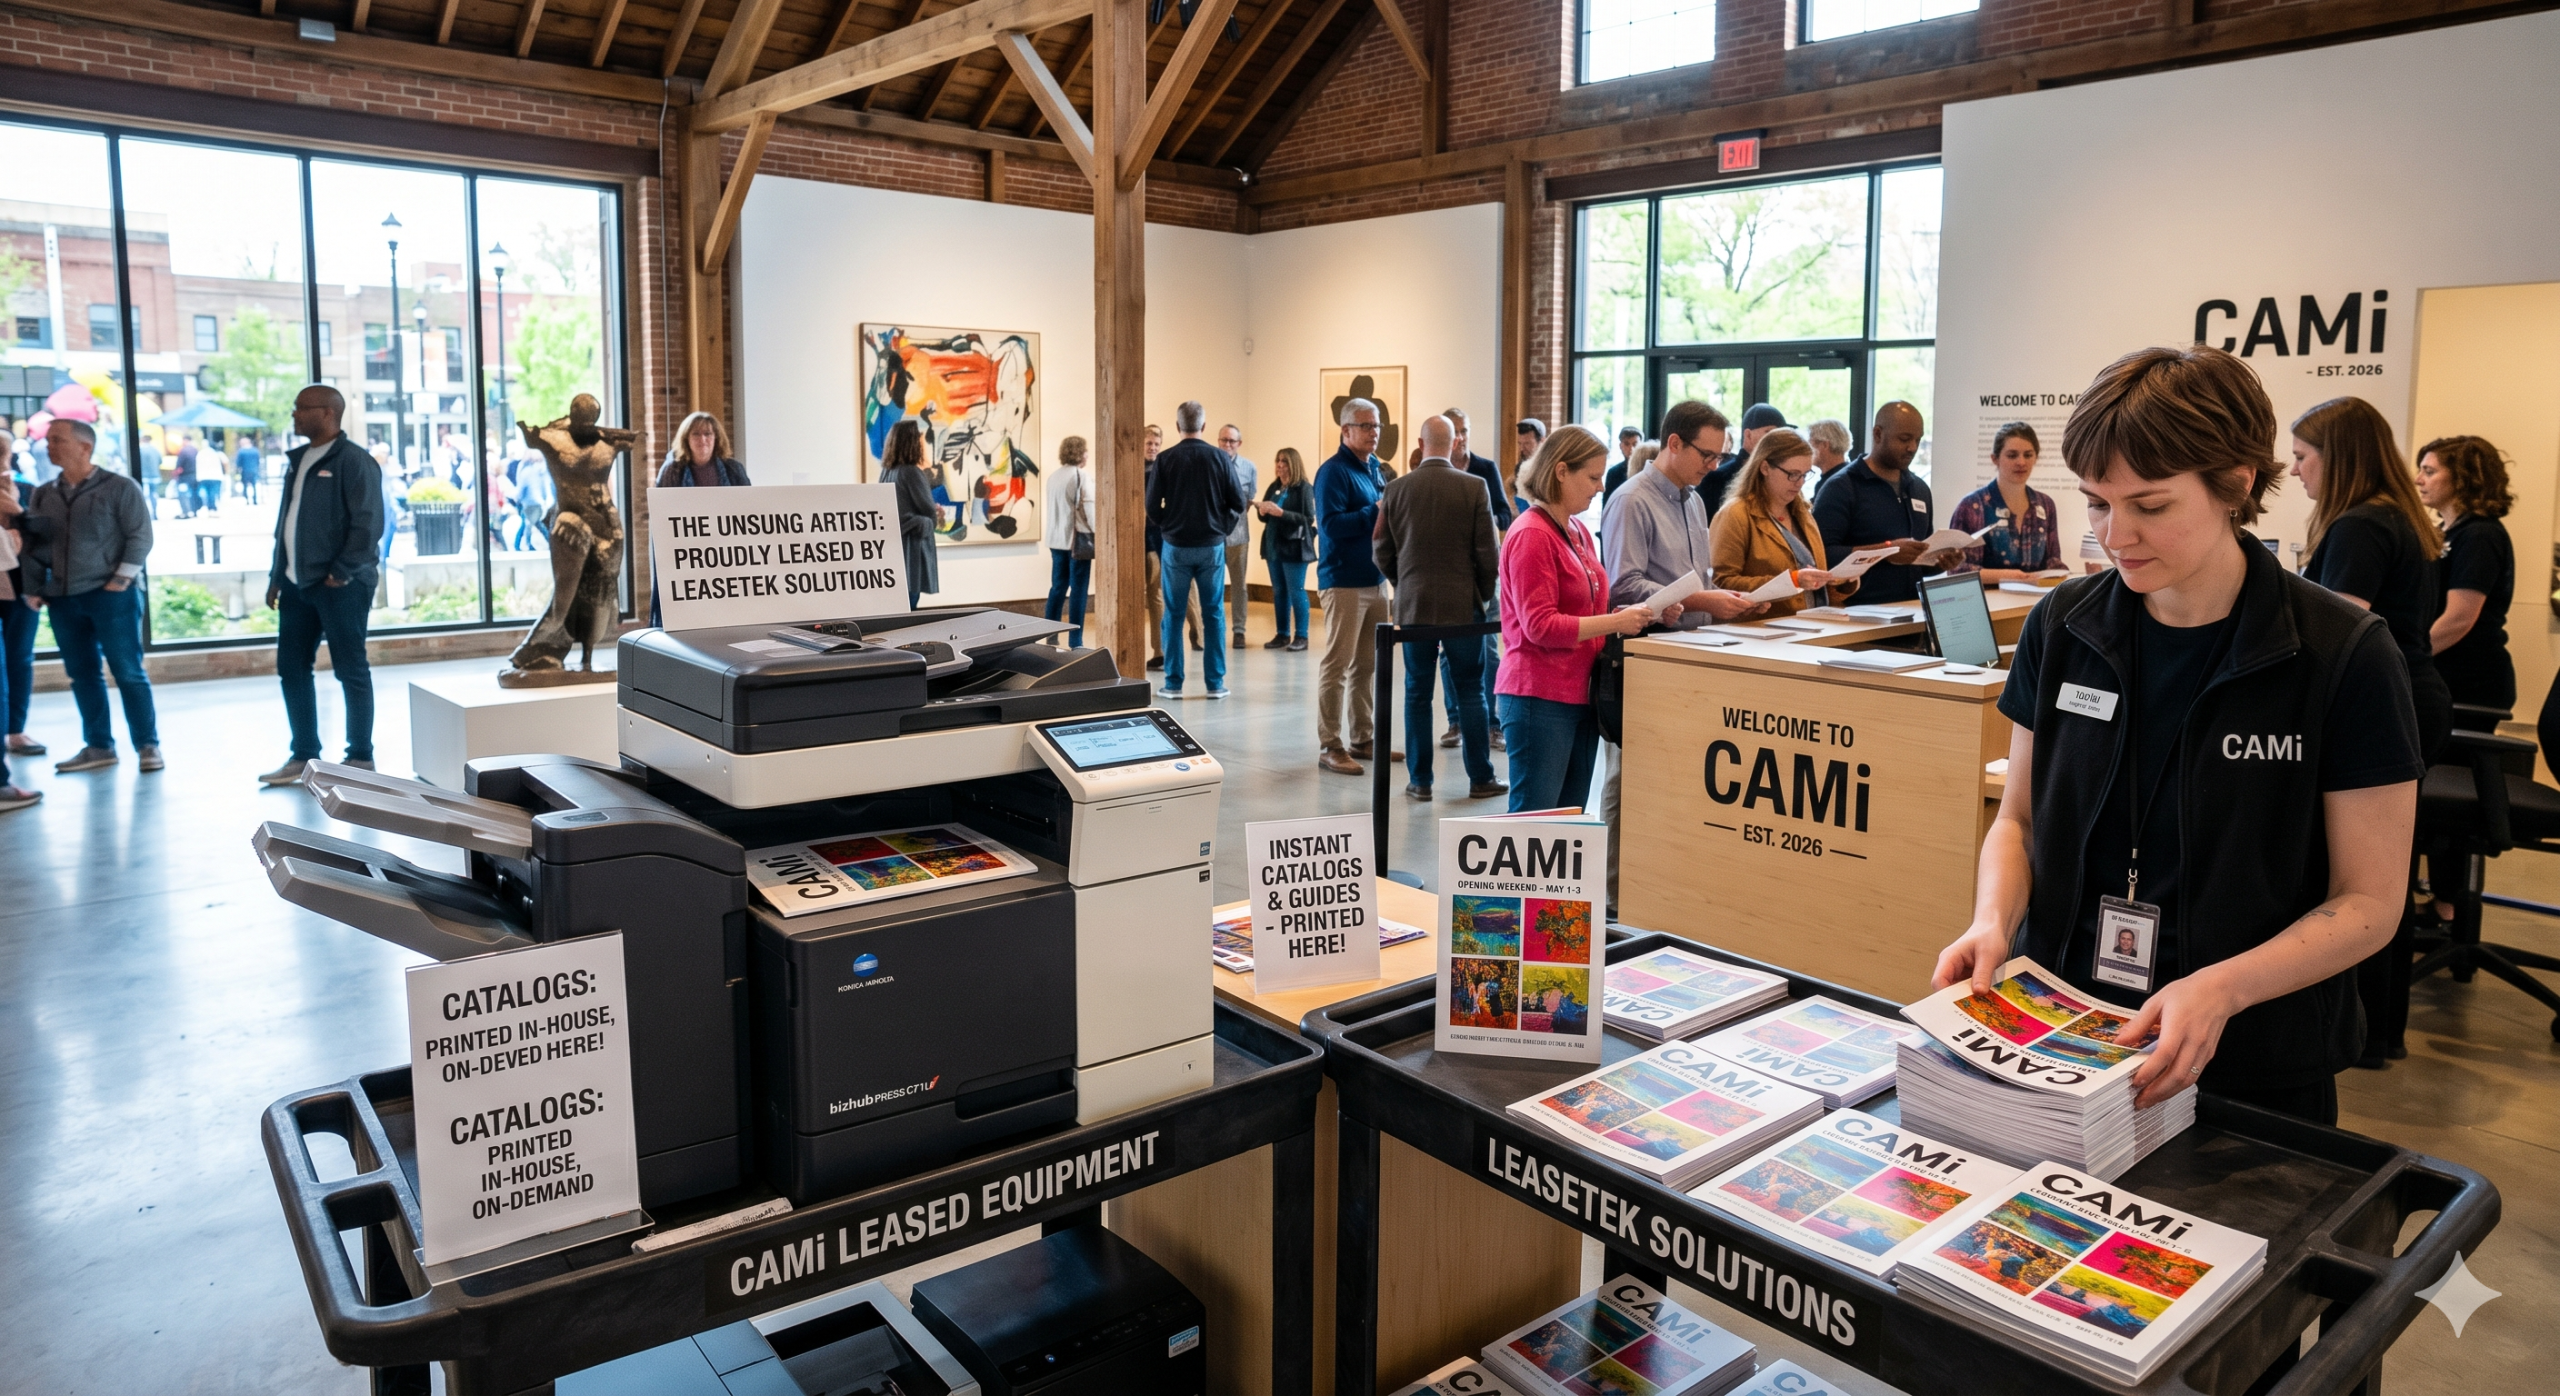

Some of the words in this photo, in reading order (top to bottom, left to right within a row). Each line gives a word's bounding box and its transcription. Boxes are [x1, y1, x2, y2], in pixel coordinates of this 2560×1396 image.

[1723, 139, 1755, 169] EXIT
[2194, 289, 2388, 358] CAMi
[2317, 365, 2344, 377] EST.
[2348, 364, 2384, 376] 2026
[1980, 394, 2037, 407] WELCOME
[2040, 394, 2055, 406] TO
[668, 516, 710, 538] THE
[717, 513, 803, 536] UNSUNG
[810, 511, 885, 533] ARTIST:
[674, 544, 771, 569] PROUDLY
[778, 541, 854, 564] LEASED
[860, 539, 885, 560] BY
[671, 574, 779, 601] LEASETEK
[785, 568, 896, 594] SOLUTIONS
[1723, 706, 1821, 743] WELCOME
[1827, 722, 1854, 748] TO
[2222, 733, 2302, 762] CAMi
[1704, 739, 1871, 833] CAMi
[1269, 834, 1352, 860] INSTANT
[1458, 834, 1583, 880] CAMi
[1743, 823, 1776, 847] EST.
[1781, 832, 1823, 857] 2026
[1261, 858, 1362, 885] CATALOGS
[1458, 880, 1494, 890] OPENING
[1497, 882, 1537, 892] WEEKEND
[1546, 884, 1564, 893] MAY
[1567, 886, 1581, 895] 1-3
[1268, 891, 1283, 911] &
[1289, 883, 1360, 909] GUIDES
[1281, 907, 1365, 934] PRINTED
[1288, 933, 1345, 958] HERE!
[442, 969, 597, 1021] CATALOGS:
[838, 982, 864, 993] KONICA
[865, 975, 894, 987] MINOLTA
[1603, 993, 1674, 1020] CAM
[425, 1025, 512, 1060] PRINTED
[519, 1005, 615, 1041] IN-HOUSE,
[442, 1045, 542, 1083] ON-DEVED
[547, 1032, 605, 1061] HERE!
[1660, 1048, 1773, 1098] CAMi
[1735, 1047, 1849, 1086] CAMi
[1952, 1028, 2087, 1085] CAMi
[450, 1088, 604, 1145] CATALOGS:
[830, 1094, 874, 1114] bizhub
[874, 1088, 905, 1103] PRESS
[488, 1128, 573, 1166] PRINTED
[1835, 1118, 1967, 1174] CAMi
[481, 1152, 582, 1192] IN-HOUSE,
[472, 1173, 594, 1220] ON-DEMAND
[730, 1233, 825, 1297] CAMi
[839, 1191, 970, 1266] LEASED
[982, 1130, 1160, 1220] EQUIPMENT
[2042, 1174, 2194, 1241] CAMi
[1487, 1137, 1641, 1246] LEASETEK
[1649, 1215, 1856, 1346] SOLUTIONS
[1613, 1284, 1712, 1344] CAMi
